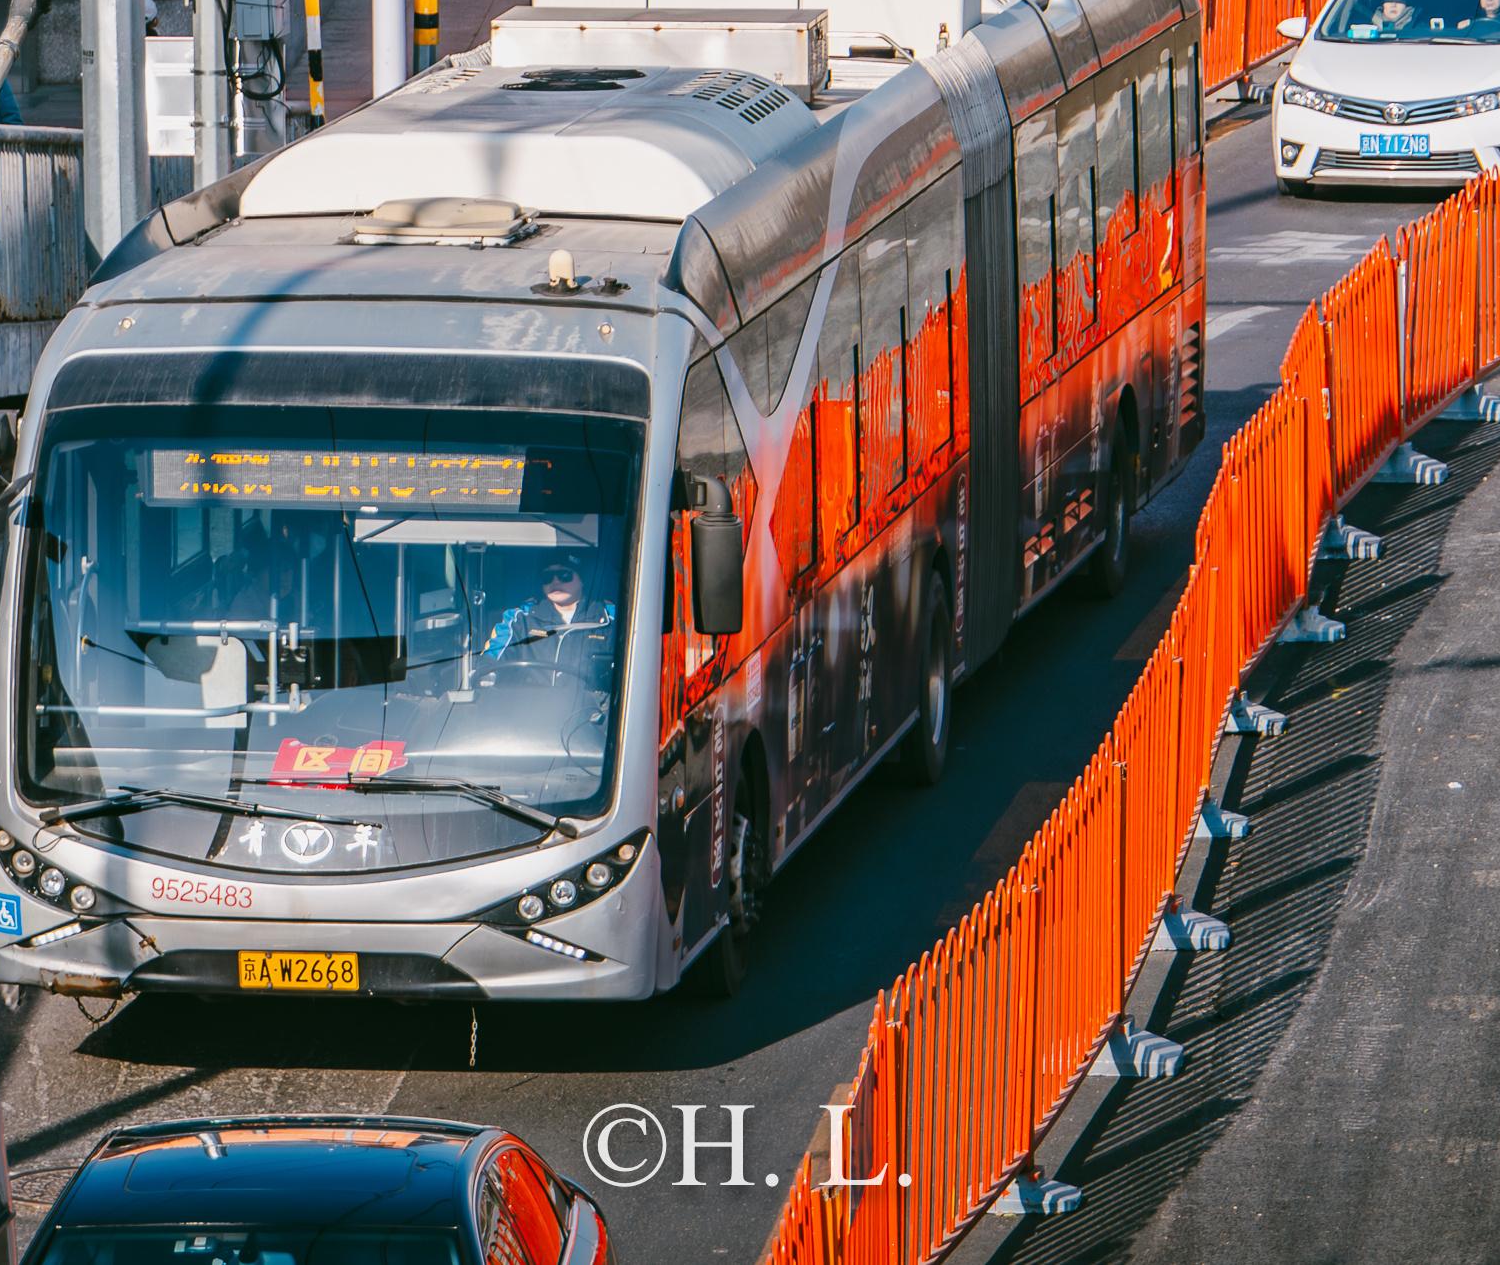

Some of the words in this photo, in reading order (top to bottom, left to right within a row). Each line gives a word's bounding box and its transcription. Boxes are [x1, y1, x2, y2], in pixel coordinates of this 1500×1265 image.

[292, 746, 393, 776] 区间
[238, 820, 267, 857] 青
[151, 876, 253, 909] 9525483
[243, 957, 354, 984] 京A·W2668
